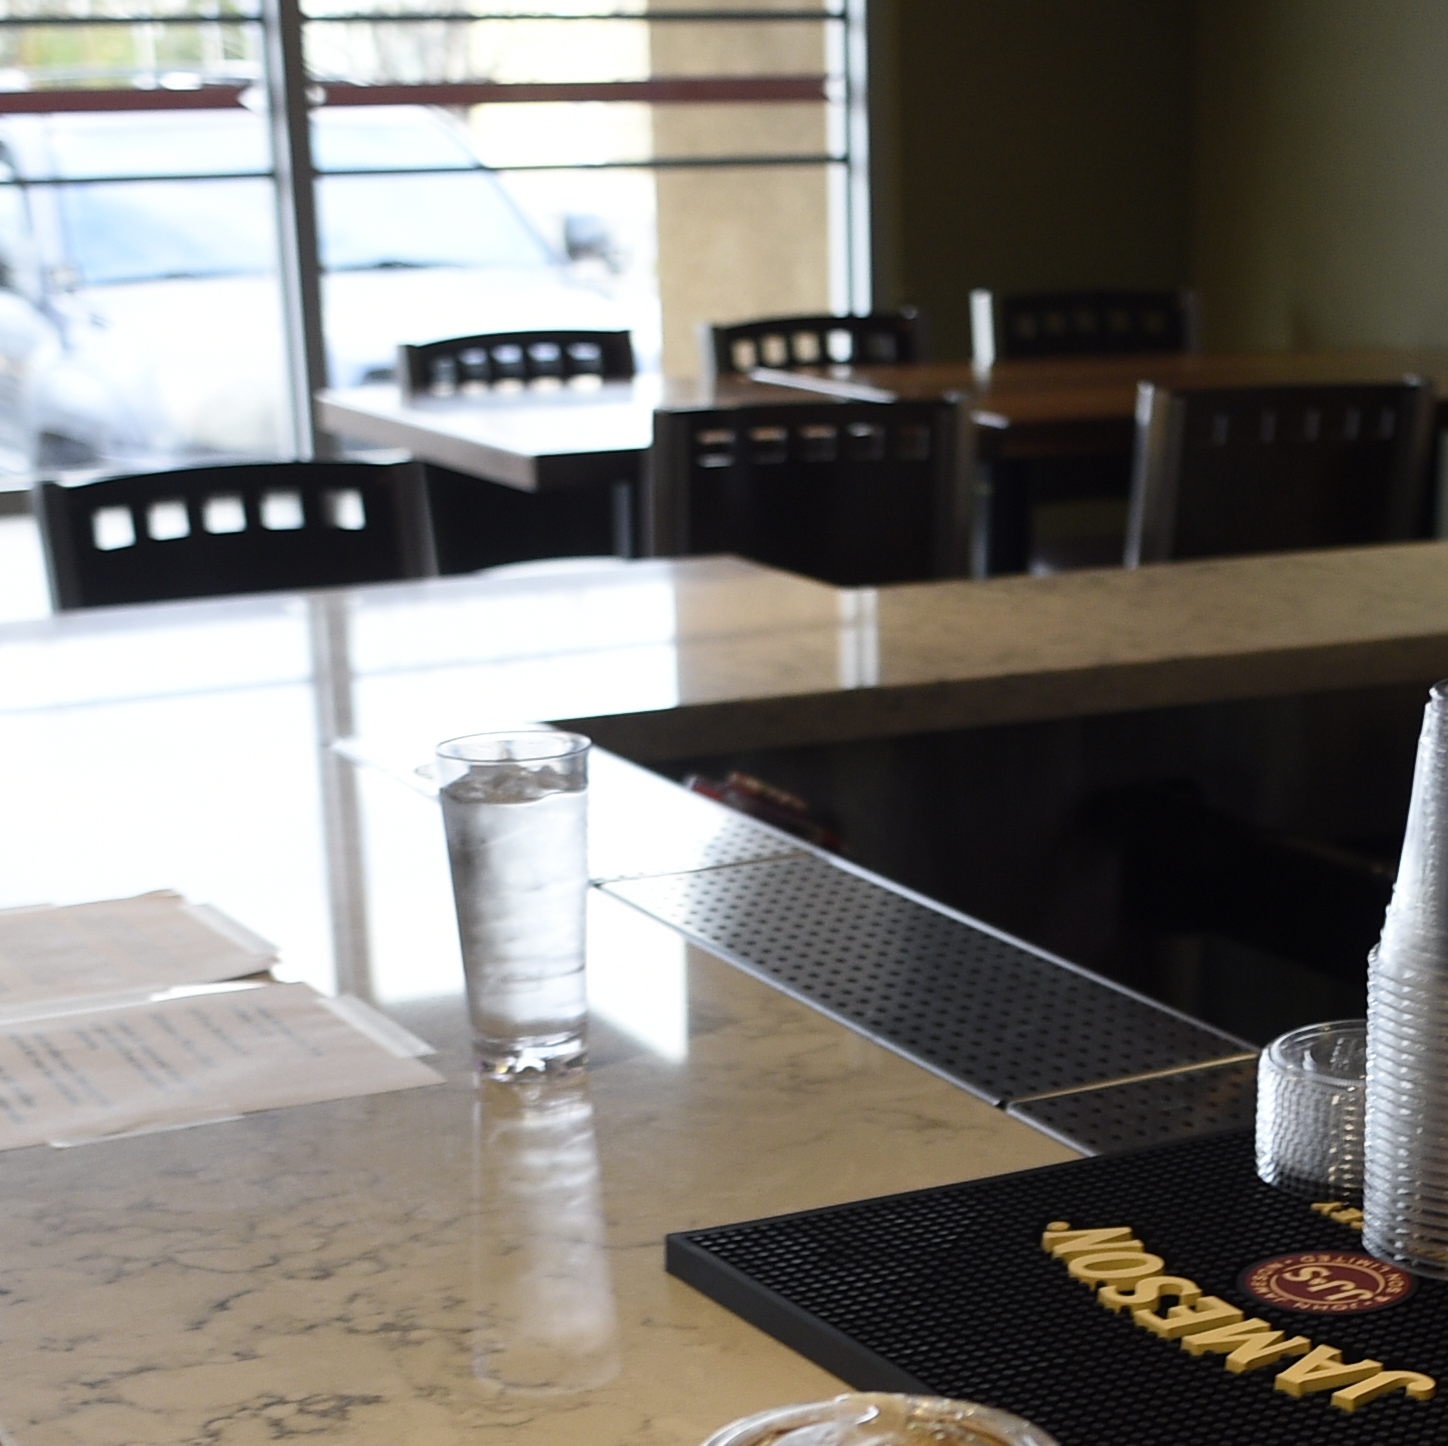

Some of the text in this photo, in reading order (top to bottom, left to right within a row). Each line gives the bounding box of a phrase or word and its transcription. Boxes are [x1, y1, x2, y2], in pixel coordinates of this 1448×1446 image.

[1300, 1255, 1391, 1272] LIMITED
[1250, 1261, 1285, 1303] JAMESON
[1042, 1222, 1437, 1412] JAMESON
[1291, 1301, 1359, 1312] JOHN
